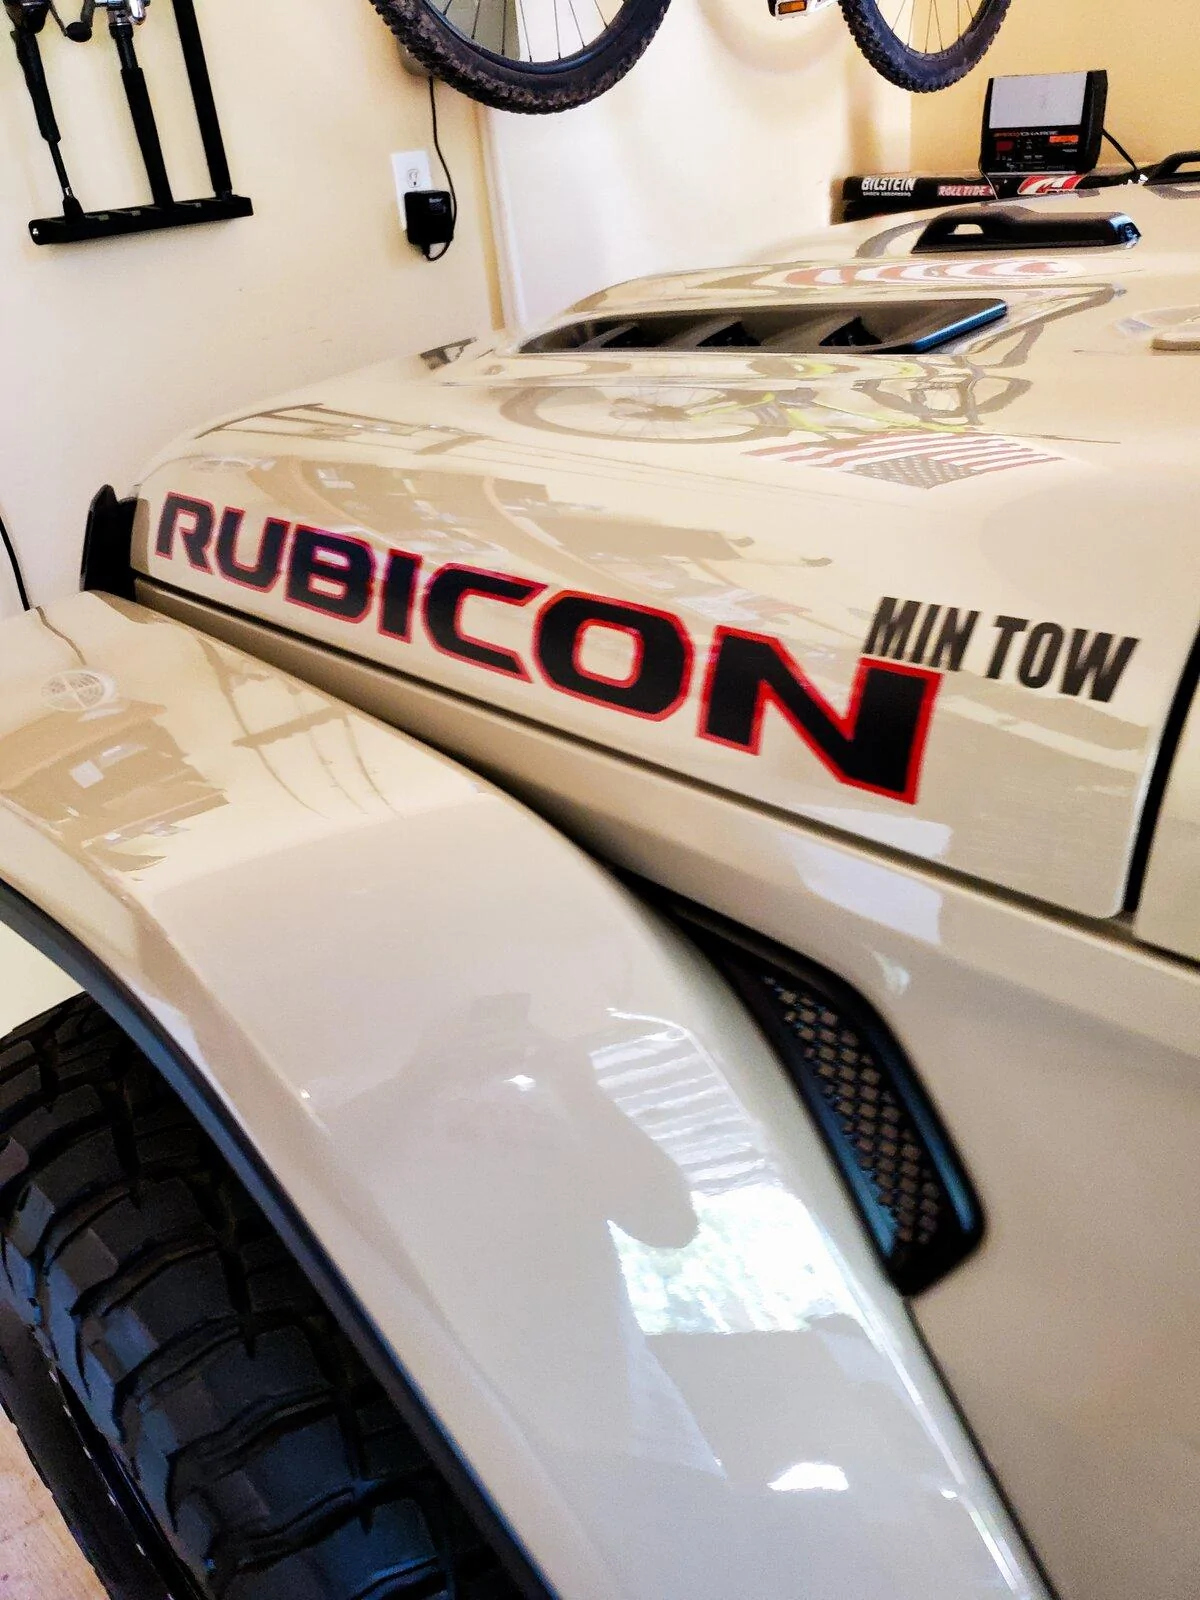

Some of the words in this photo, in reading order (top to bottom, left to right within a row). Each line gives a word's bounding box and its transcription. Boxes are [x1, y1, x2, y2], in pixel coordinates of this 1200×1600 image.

[861, 177, 916, 191] BILSTEIN
[154, 491, 944, 805] RUBICON
[862, 596, 981, 672] MIN
[984, 615, 1141, 702] TOW
